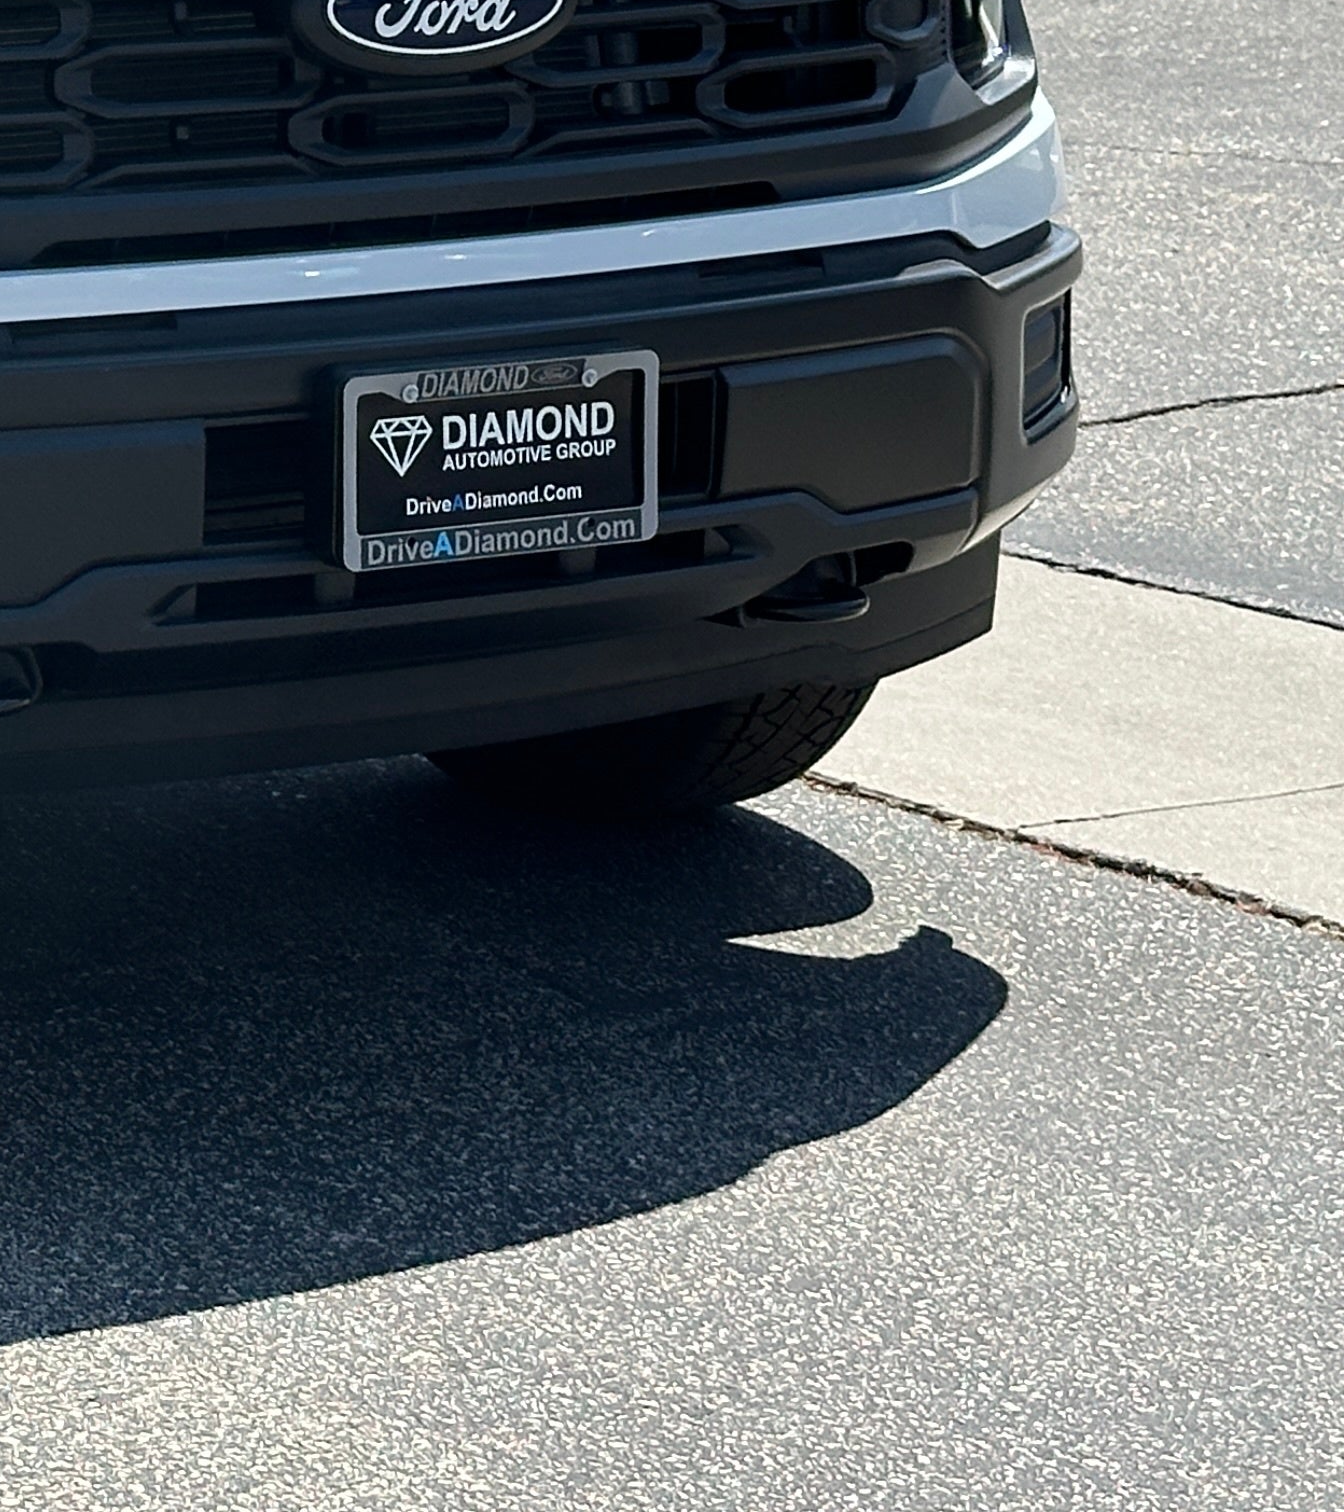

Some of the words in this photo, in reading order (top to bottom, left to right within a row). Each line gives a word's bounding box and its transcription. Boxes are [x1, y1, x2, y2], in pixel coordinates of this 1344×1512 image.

[421, 364, 530, 398] DIAMOND
[442, 401, 615, 450] DIAMOND
[442, 444, 552, 472] AUTOMOTIVE
[556, 439, 617, 460] GROUP
[405, 484, 583, 517] DriveADiamond.Com
[367, 515, 636, 567] DriveADiamond.Com
